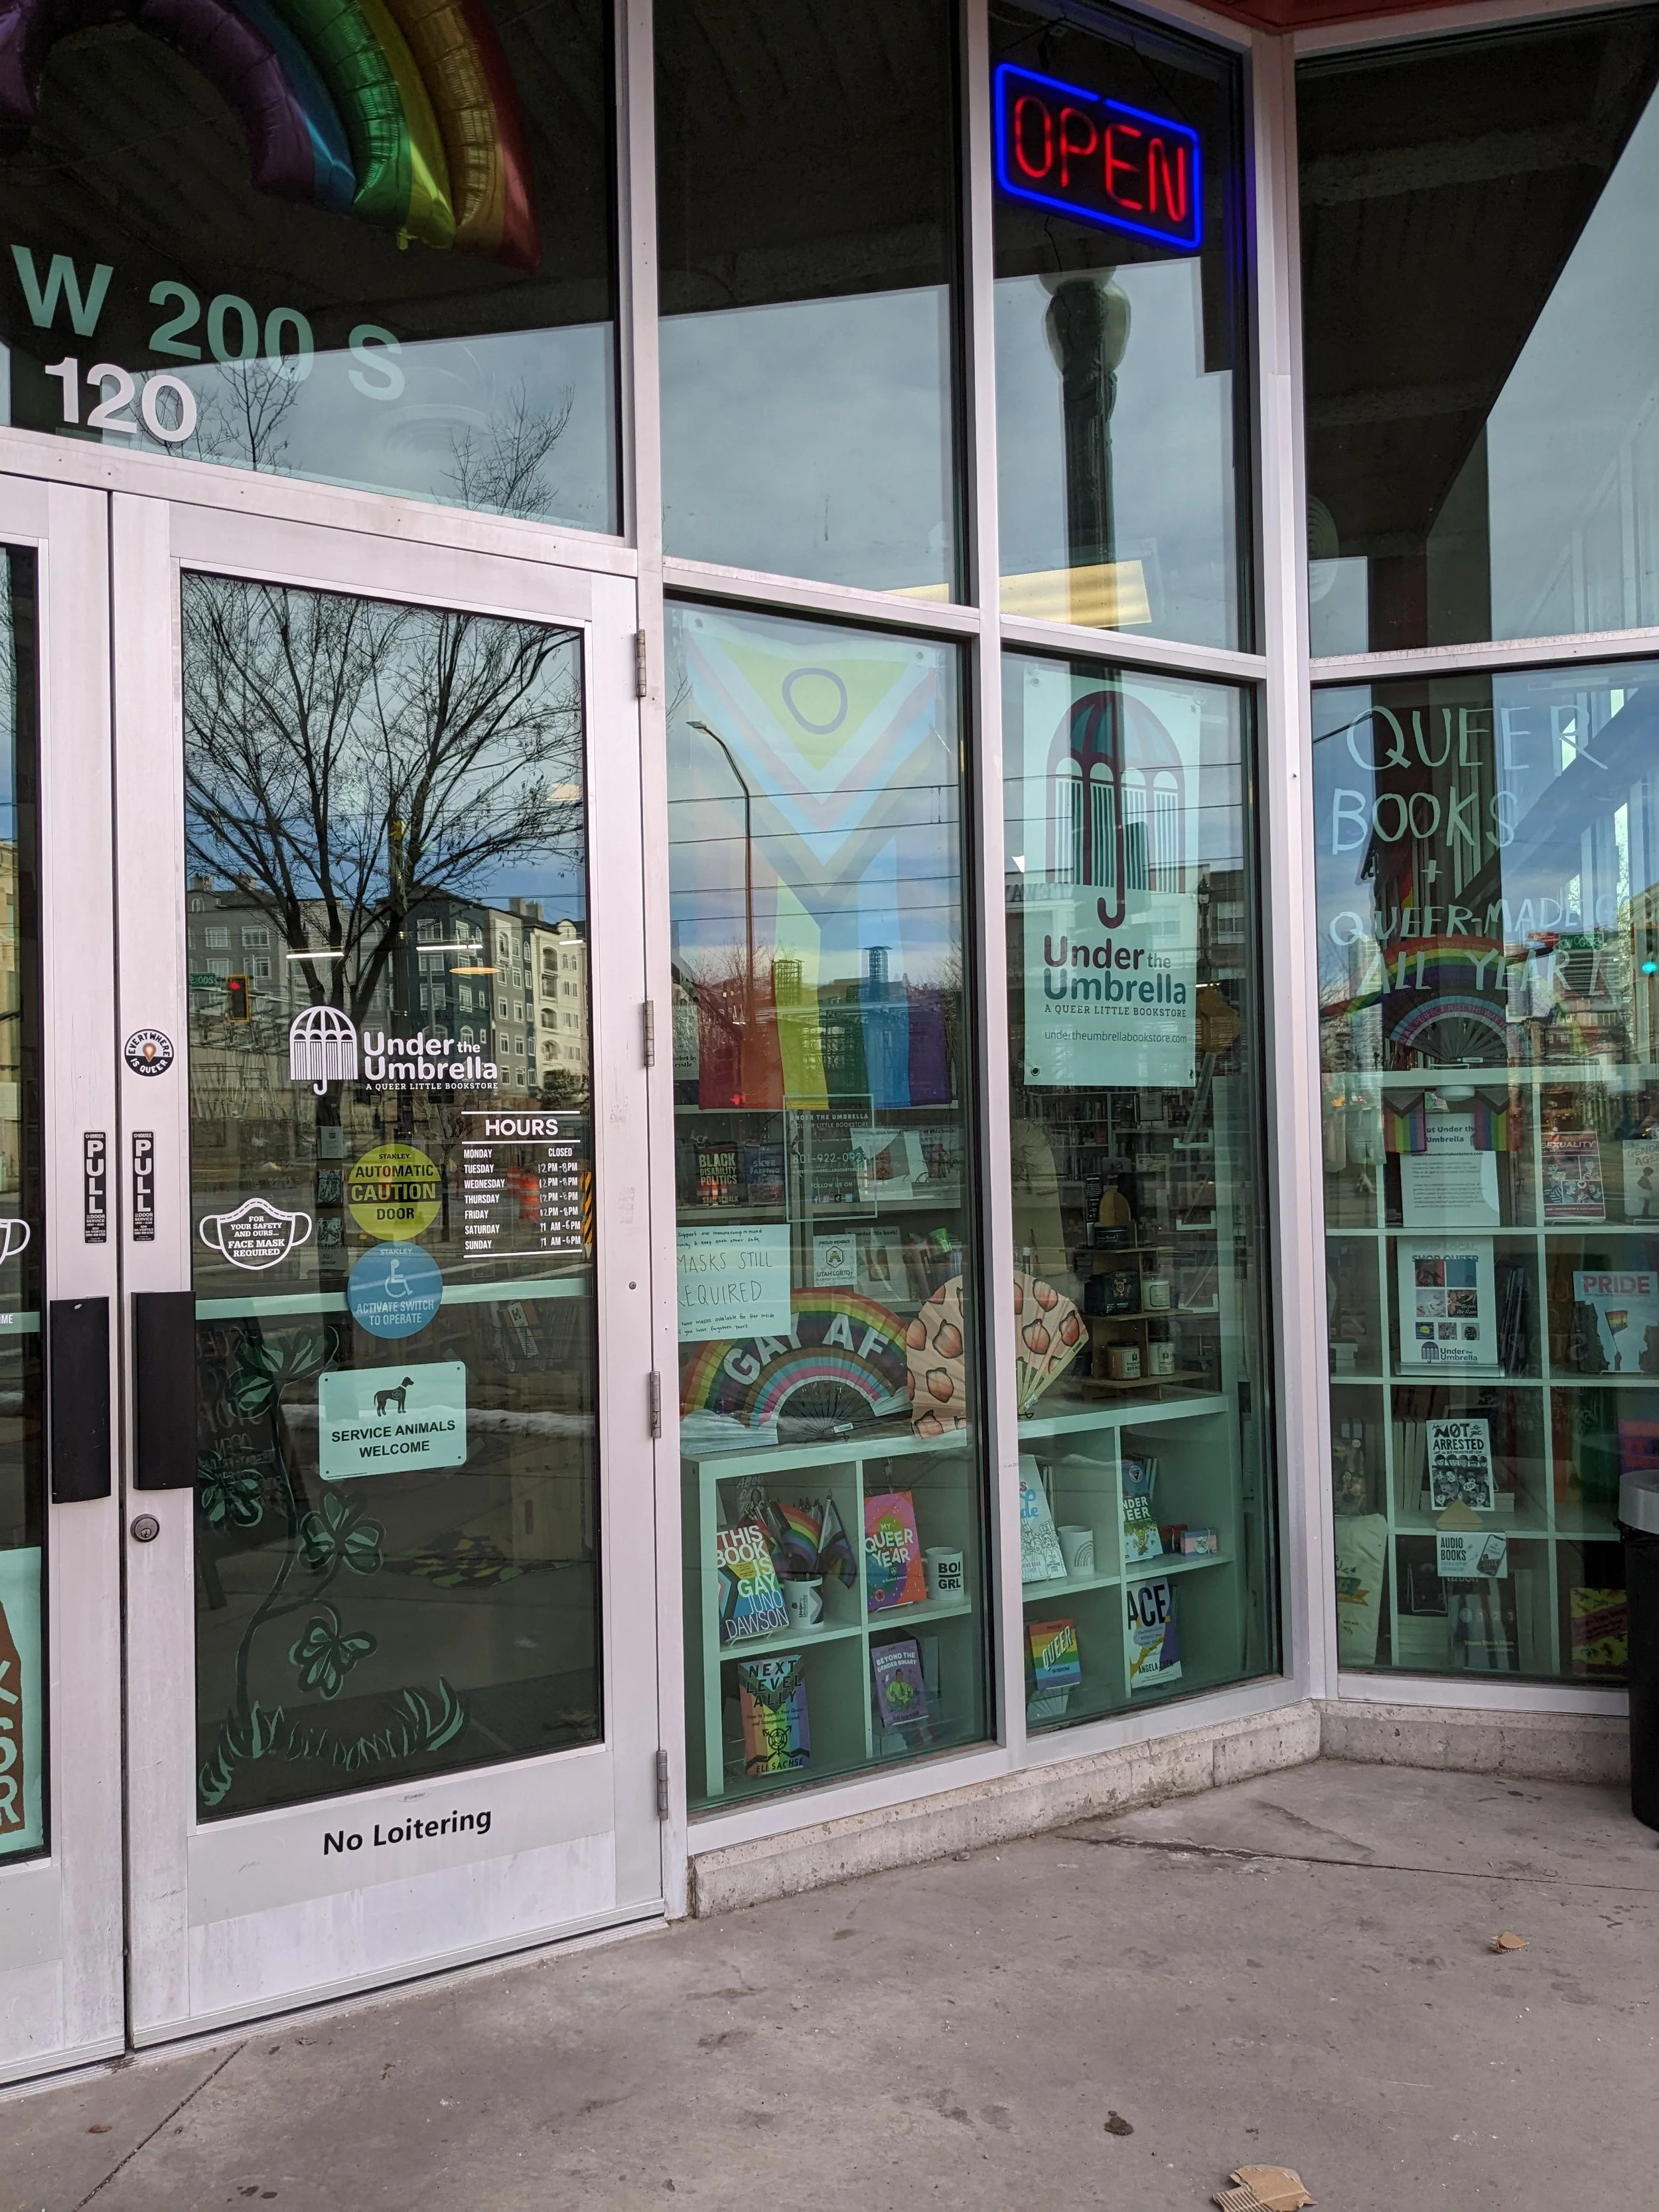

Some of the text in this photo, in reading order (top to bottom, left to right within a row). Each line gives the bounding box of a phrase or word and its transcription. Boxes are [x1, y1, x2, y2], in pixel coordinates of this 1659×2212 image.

[1014, 96, 1187, 222] OPEN
[11, 244, 405, 400] W 200 S
[44, 357, 197, 441] 120
[1346, 705, 1608, 776] QUEER
[1333, 786, 1518, 855] BOOKS
[1044, 934, 1171, 970] Under the
[1358, 948, 1570, 995] ALL YEAR
[1044, 968, 1186, 1004] Umbrella
[1055, 1005, 1090, 1014] QUEER
[1094, 1006, 1129, 1015] LITTLE
[1133, 1008, 1187, 1017] BOOKSTORE
[128, 1032, 170, 1057] EVERYWHERE
[364, 1032, 480, 1056] Under the
[1045, 1031, 1187, 1043] undertheumbrellabookstore.com
[130, 1058, 168, 1074] IS QUEER
[364, 1057, 498, 1080] Umbrella
[485, 1119, 559, 1136] HOURS
[464, 1147, 573, 1158] MONDAY CLOSED
[1542, 1141, 1597, 1149] SEXUALITY
[464, 1164, 494, 1173] TUESDAY
[699, 1153, 737, 1167] BLACK
[86, 1140, 104, 1213] PULL
[135, 1140, 152, 1212] PULL
[355, 1164, 434, 1178] AUTOMATIC
[699, 1167, 737, 1176] DISABILITY
[464, 1179, 505, 1189] WEDNESDAY
[701, 1175, 737, 1186] POLITICS
[351, 1183, 436, 1202] CAUTION
[465, 1194, 500, 1204] THURSDAY
[376, 1207, 415, 1220] DOOR
[465, 1210, 488, 1219] FRIDAY
[465, 1224, 500, 1234] SATURDAY
[228, 1238, 285, 1249] FACE MASK
[465, 1240, 492, 1250] SUNDAY
[233, 1248, 280, 1258] REQUIRED
[677, 1252, 773, 1273] MASKS STILL
[1583, 1276, 1650, 1294] PRIDE
[356, 1299, 434, 1314] ACTIVATE SWITCH
[369, 1313, 421, 1326] TO OPERATE
[822, 1313, 890, 1360] AF
[331, 1420, 455, 1442] SERVICE ANIMALS
[1434, 1423, 1470, 1438] NOT
[359, 1440, 430, 1458] WELCOME
[1433, 1439, 1484, 1451] ARRESTED
[717, 1525, 762, 1548] THIS
[865, 1528, 914, 1553] QUEER
[1441, 1537, 1463, 1548] AUDIO
[717, 1540, 770, 1568] BOOK
[872, 1548, 910, 1568] YEAR
[1441, 1550, 1467, 1561] BOOKS
[752, 1557, 774, 1578] IS
[737, 1573, 776, 1597] GAY
[938, 1579, 961, 1589] GRL
[747, 1589, 784, 1615] JUNO
[1127, 1584, 1165, 1629] ACE
[725, 1607, 790, 1639] DAWSON
[1042, 1625, 1072, 1671] QUEER
[876, 1653, 902, 1666] BEYOND
[877, 1661, 897, 1672] GENDER
[1138, 1662, 1159, 1674] ANGELA
[749, 1660, 796, 1678] NEXT
[746, 1674, 802, 1694] LEVEL
[753, 1690, 796, 1708] ALLY
[756, 1759, 804, 1773] ELI SACHSE
[324, 1810, 491, 1855] No Loitering
